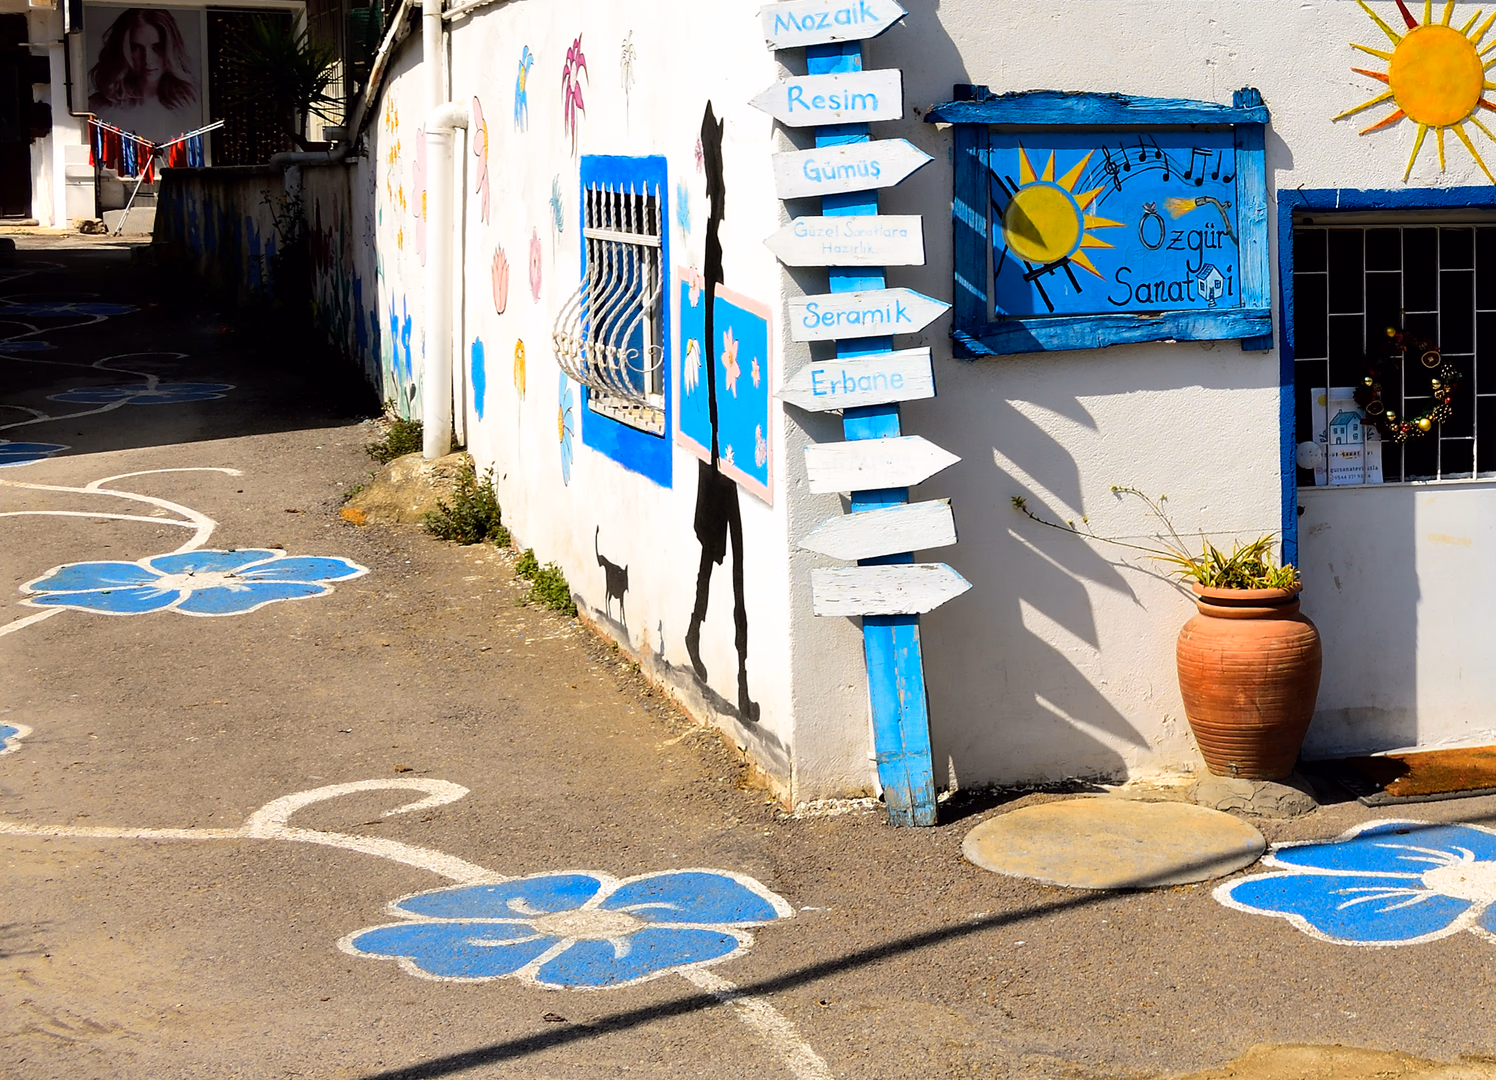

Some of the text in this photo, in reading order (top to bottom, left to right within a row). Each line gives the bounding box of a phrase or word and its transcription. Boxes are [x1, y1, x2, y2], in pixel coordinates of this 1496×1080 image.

[774, 0, 880, 37] Mozaik
[787, 84, 879, 113] Resim
[802, 158, 881, 183] Gümüş
[794, 220, 908, 238] Güzel Sanatlara
[1138, 202, 1229, 273] Özgür
[802, 300, 912, 329] Seramik
[811, 368, 904, 397] Erbane
